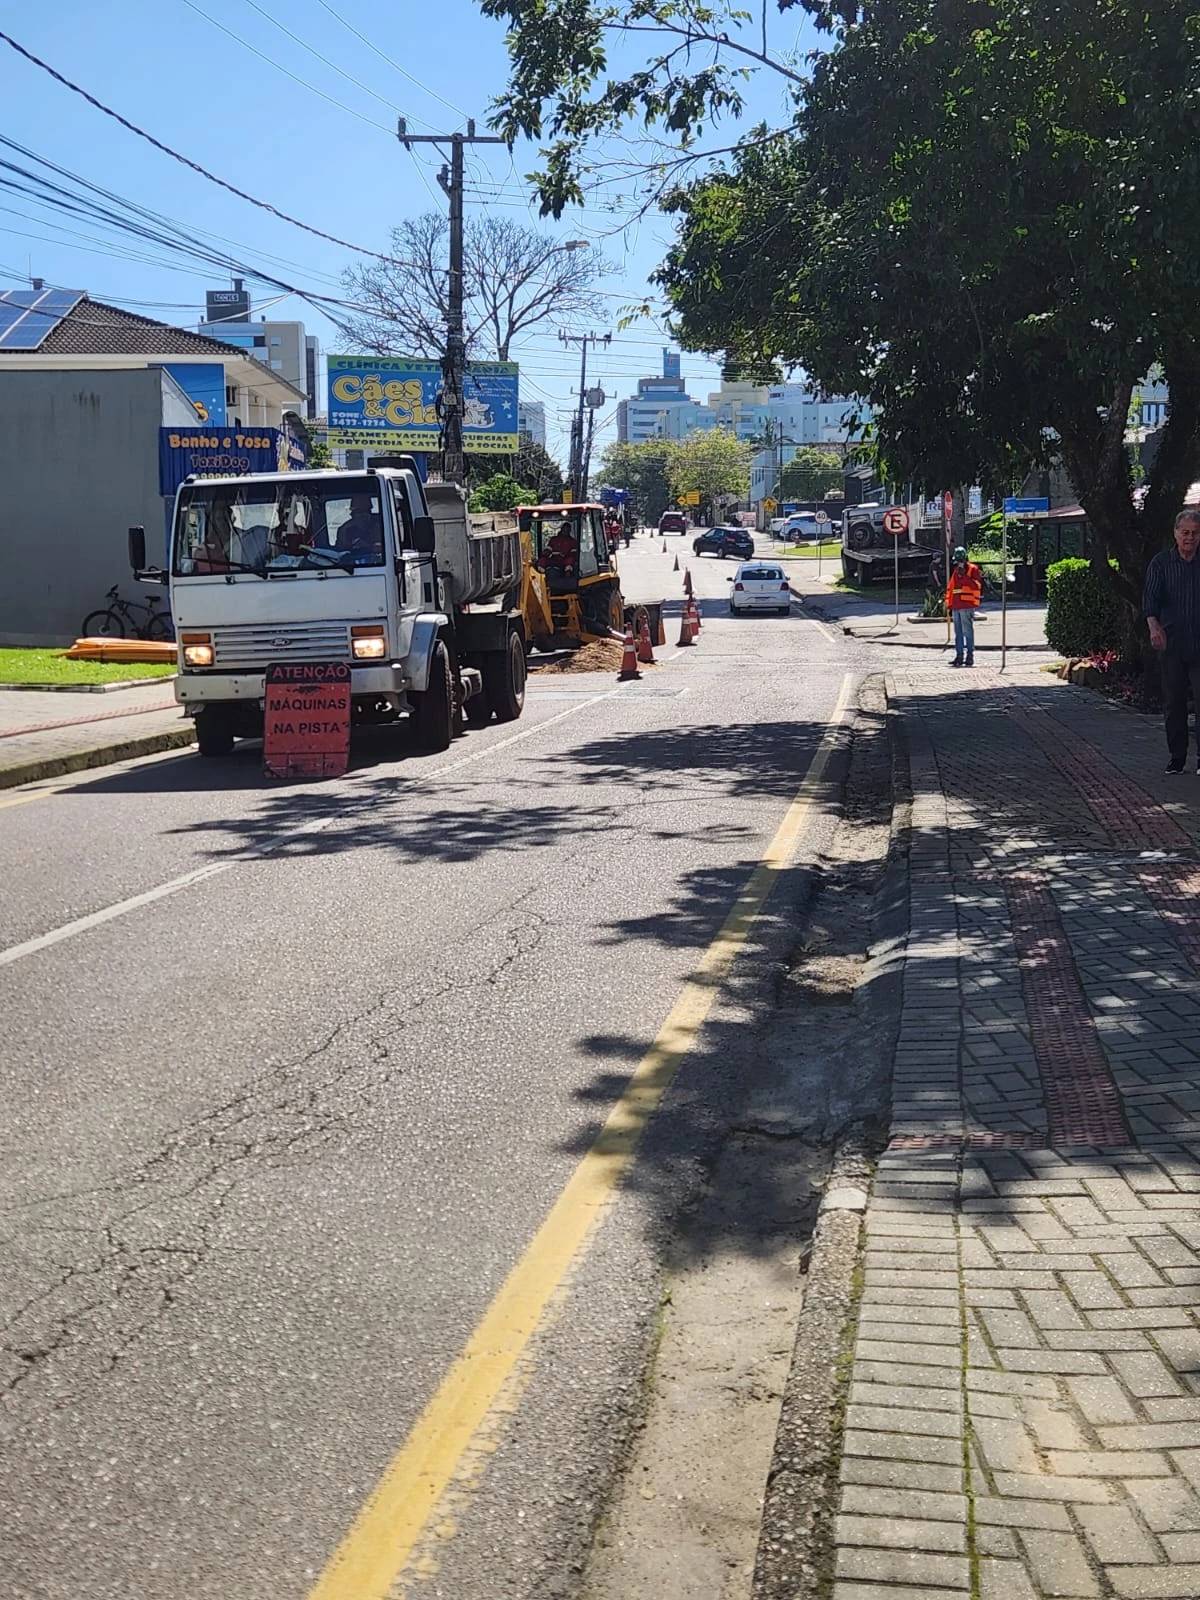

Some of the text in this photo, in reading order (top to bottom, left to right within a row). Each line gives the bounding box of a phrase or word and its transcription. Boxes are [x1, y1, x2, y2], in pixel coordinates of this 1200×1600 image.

[332, 375, 422, 403] Cães
[364, 399, 443, 425] & Cia
[169, 434, 271, 448] Banho e Tosa
[190, 454, 249, 470] TaxiDog
[891, 514, 902, 529] E
[272, 663, 348, 679] ATENÇÃO
[269, 697, 346, 711] MÁQUINAS
[274, 722, 340, 734] NA PISTA
